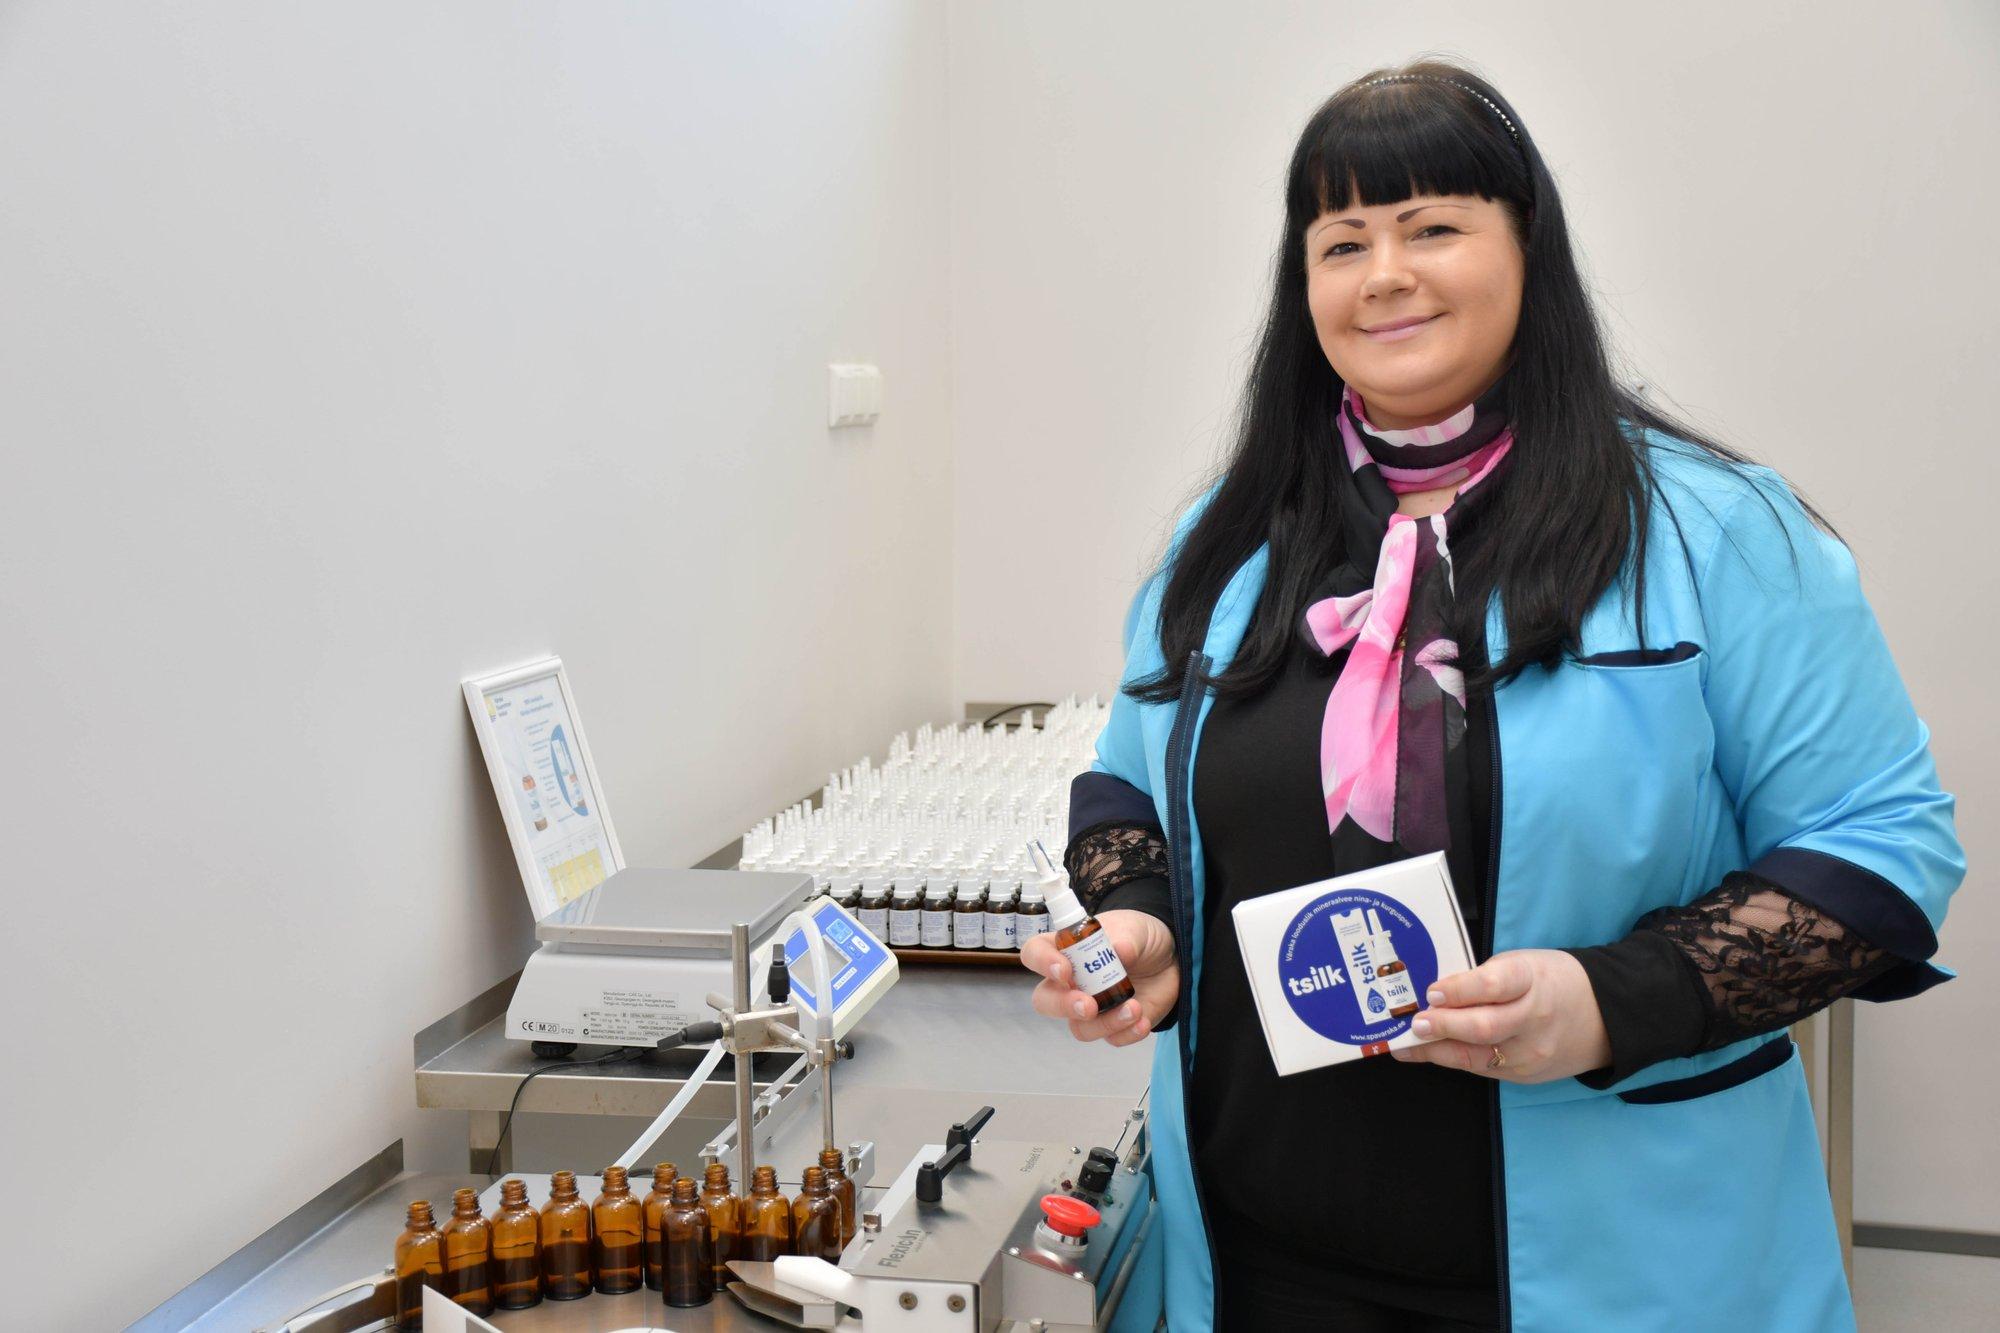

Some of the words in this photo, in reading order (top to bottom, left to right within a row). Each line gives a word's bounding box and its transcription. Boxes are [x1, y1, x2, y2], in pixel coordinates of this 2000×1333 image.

[1291, 911, 1314, 938] looduslik
[1312, 896, 1353, 914] mineraalvee
[1353, 896, 1372, 904] nina-
[1372, 898, 1380, 907] ja
[1380, 902, 1413, 929] kurgusprei
[1084, 947, 1117, 974] tsilk
[1351, 942, 1376, 984] tsilk
[1288, 964, 1346, 997] tsilk
[1387, 985, 1408, 997] tsilk
[547, 1024, 558, 1033] 20
[1350, 1020, 1406, 1041] www.spavarska.ee
